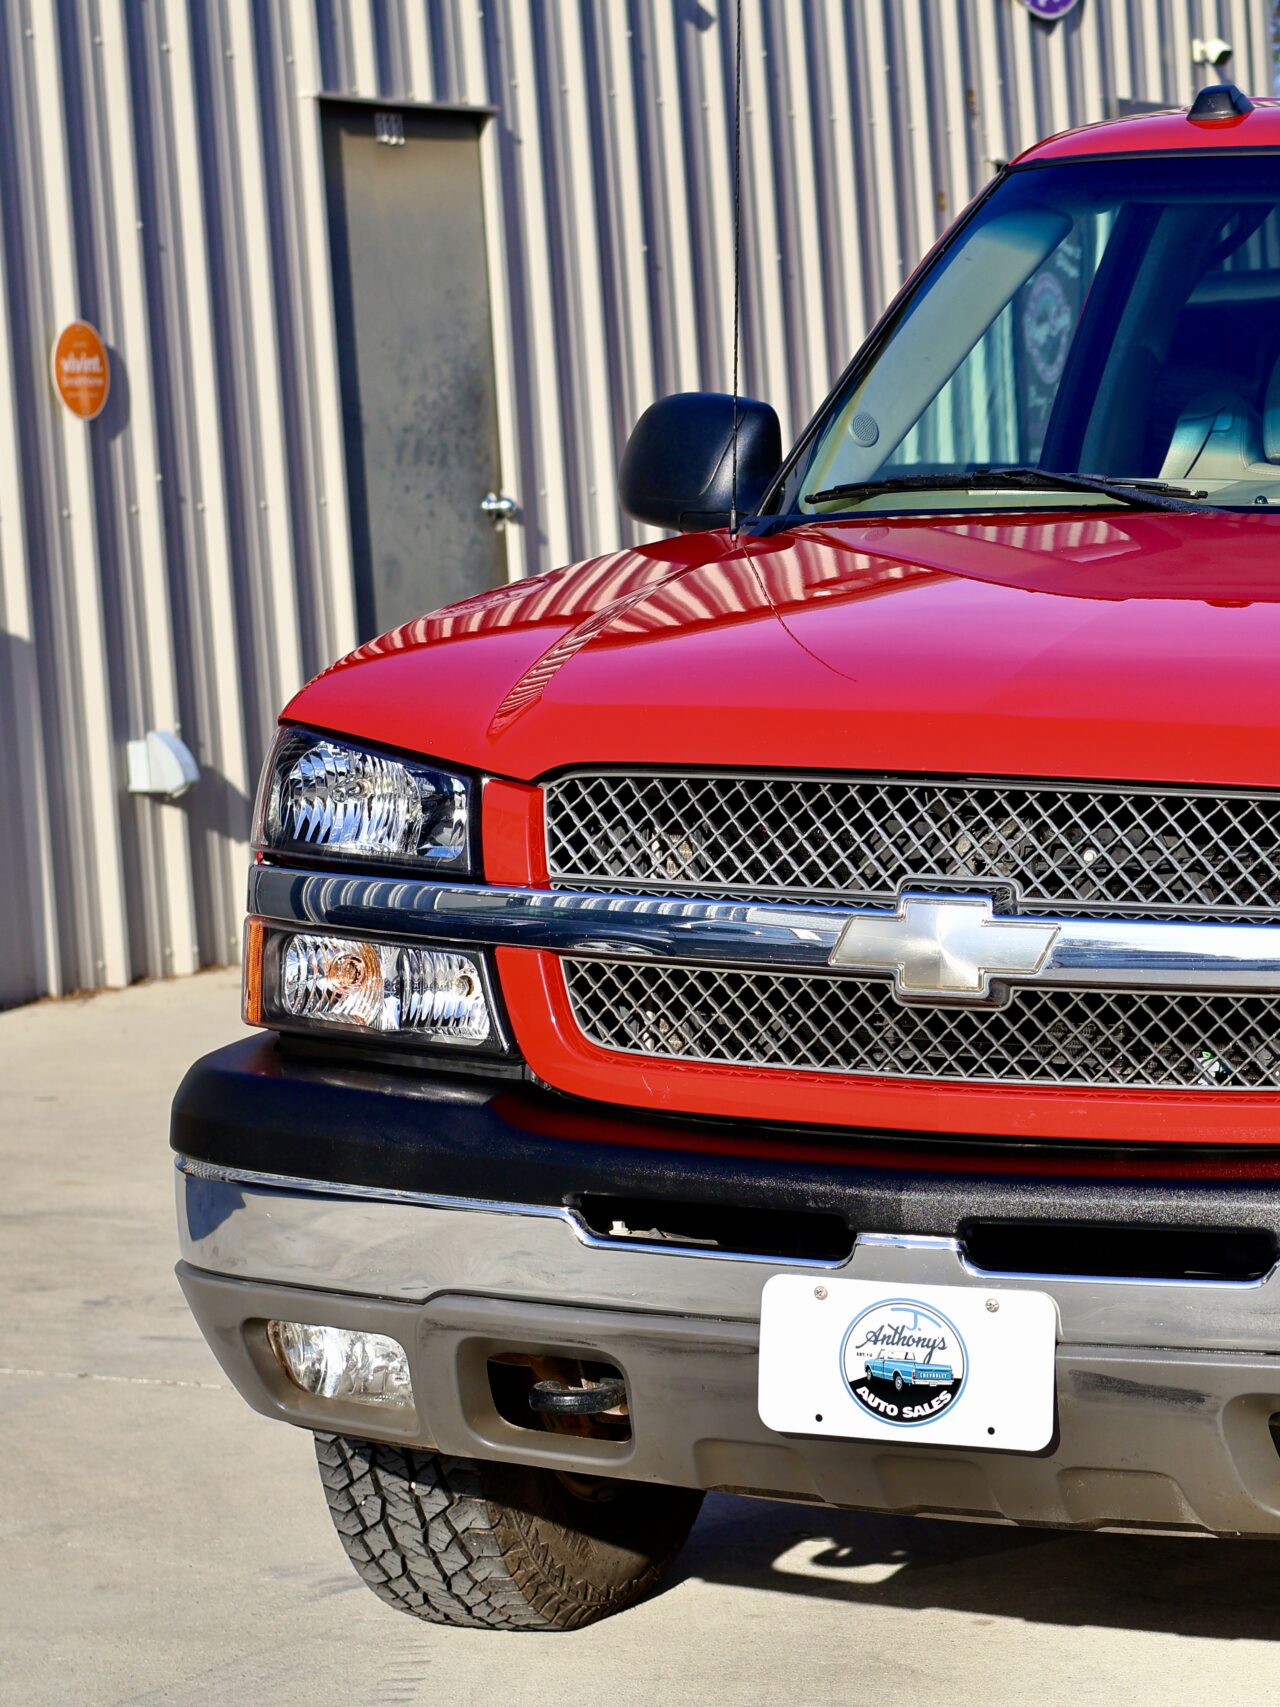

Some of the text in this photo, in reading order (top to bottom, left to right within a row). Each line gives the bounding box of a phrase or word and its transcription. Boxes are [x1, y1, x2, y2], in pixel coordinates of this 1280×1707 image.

[855, 1323, 948, 1365] Anthony's
[855, 1385, 953, 1419] AUTO SALES
